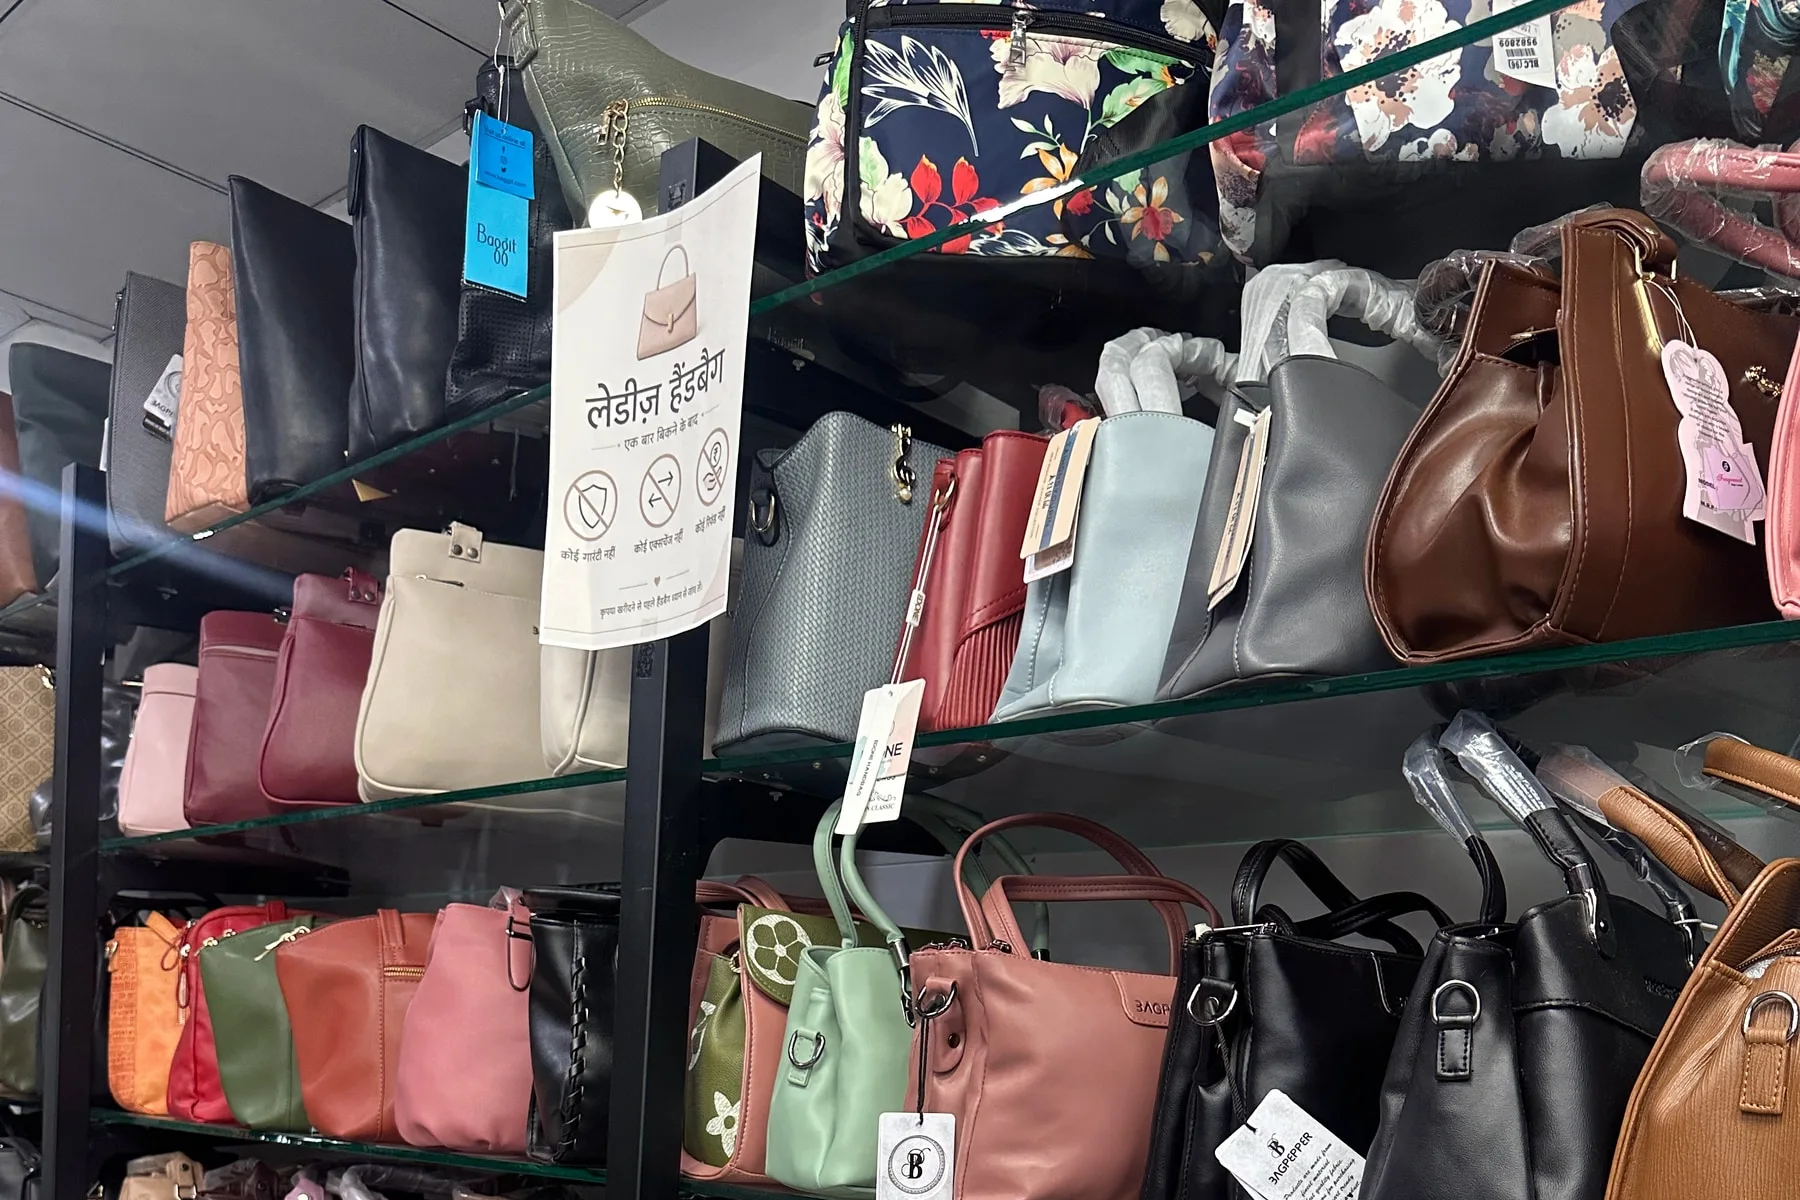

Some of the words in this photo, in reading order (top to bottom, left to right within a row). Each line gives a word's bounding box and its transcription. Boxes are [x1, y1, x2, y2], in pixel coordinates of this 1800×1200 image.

[477, 222, 517, 268] Baggit
[586, 377, 662, 430] लेडीज़
[669, 347, 726, 413] हैंडबैग
[624, 437, 639, 451] एक
[641, 433, 655, 445] बार
[657, 421, 678, 442] बिकने
[680, 418, 687, 432] के
[687, 413, 698, 427] बाद
[560, 547, 580, 563] कोई
[604, 545, 616, 560] नहीं
[634, 538, 648, 553] कोई
[1284, 1180, 1303, 1200] Products
[1311, 1156, 1321, 1169] made
[1322, 1144, 1331, 1156] from
[1313, 1159, 1329, 1181] material
[1334, 1159, 1354, 1186] purchasing
